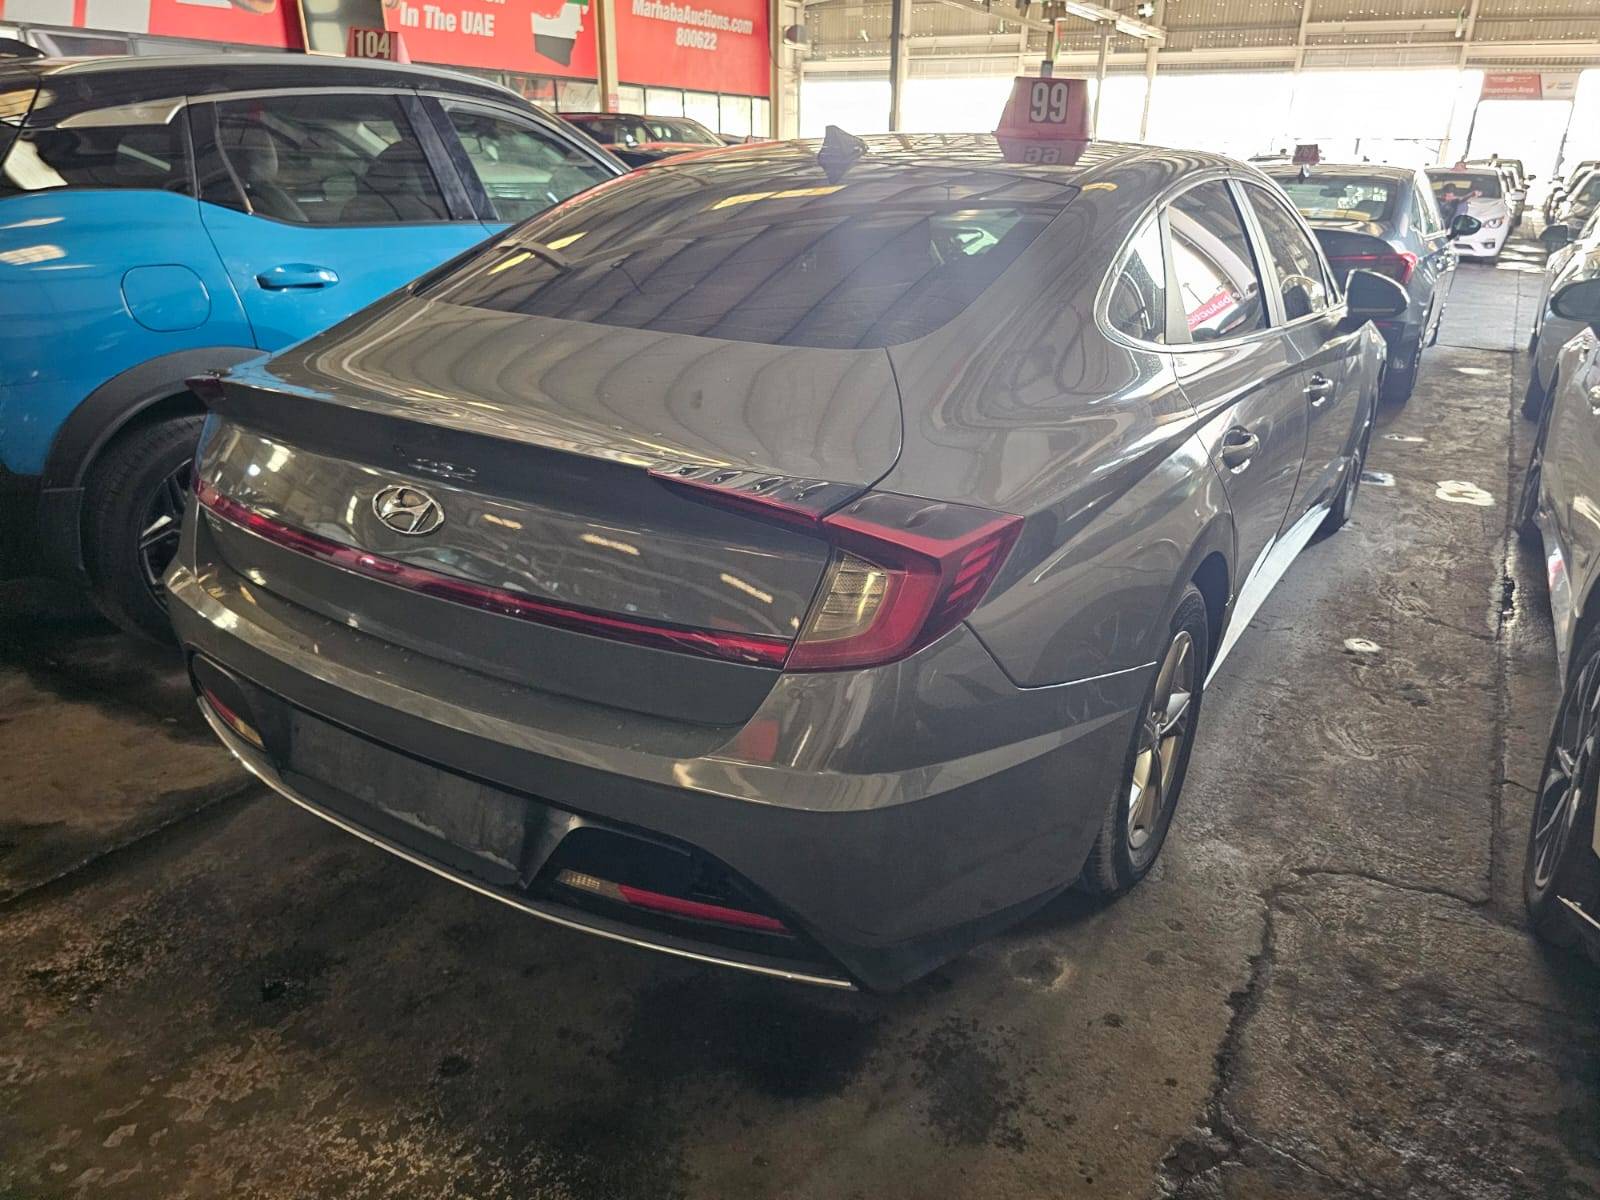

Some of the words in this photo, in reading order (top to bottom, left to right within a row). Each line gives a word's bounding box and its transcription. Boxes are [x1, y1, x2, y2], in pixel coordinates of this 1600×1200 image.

[400, 2, 419, 27] In
[423, 5, 457, 32] The
[461, 10, 496, 37] UAE
[632, 0, 753, 35] MarhabaAuctions.com
[356, 30, 390, 59] 104
[675, 27, 718, 50] 800622
[1031, 82, 1068, 122] 99
